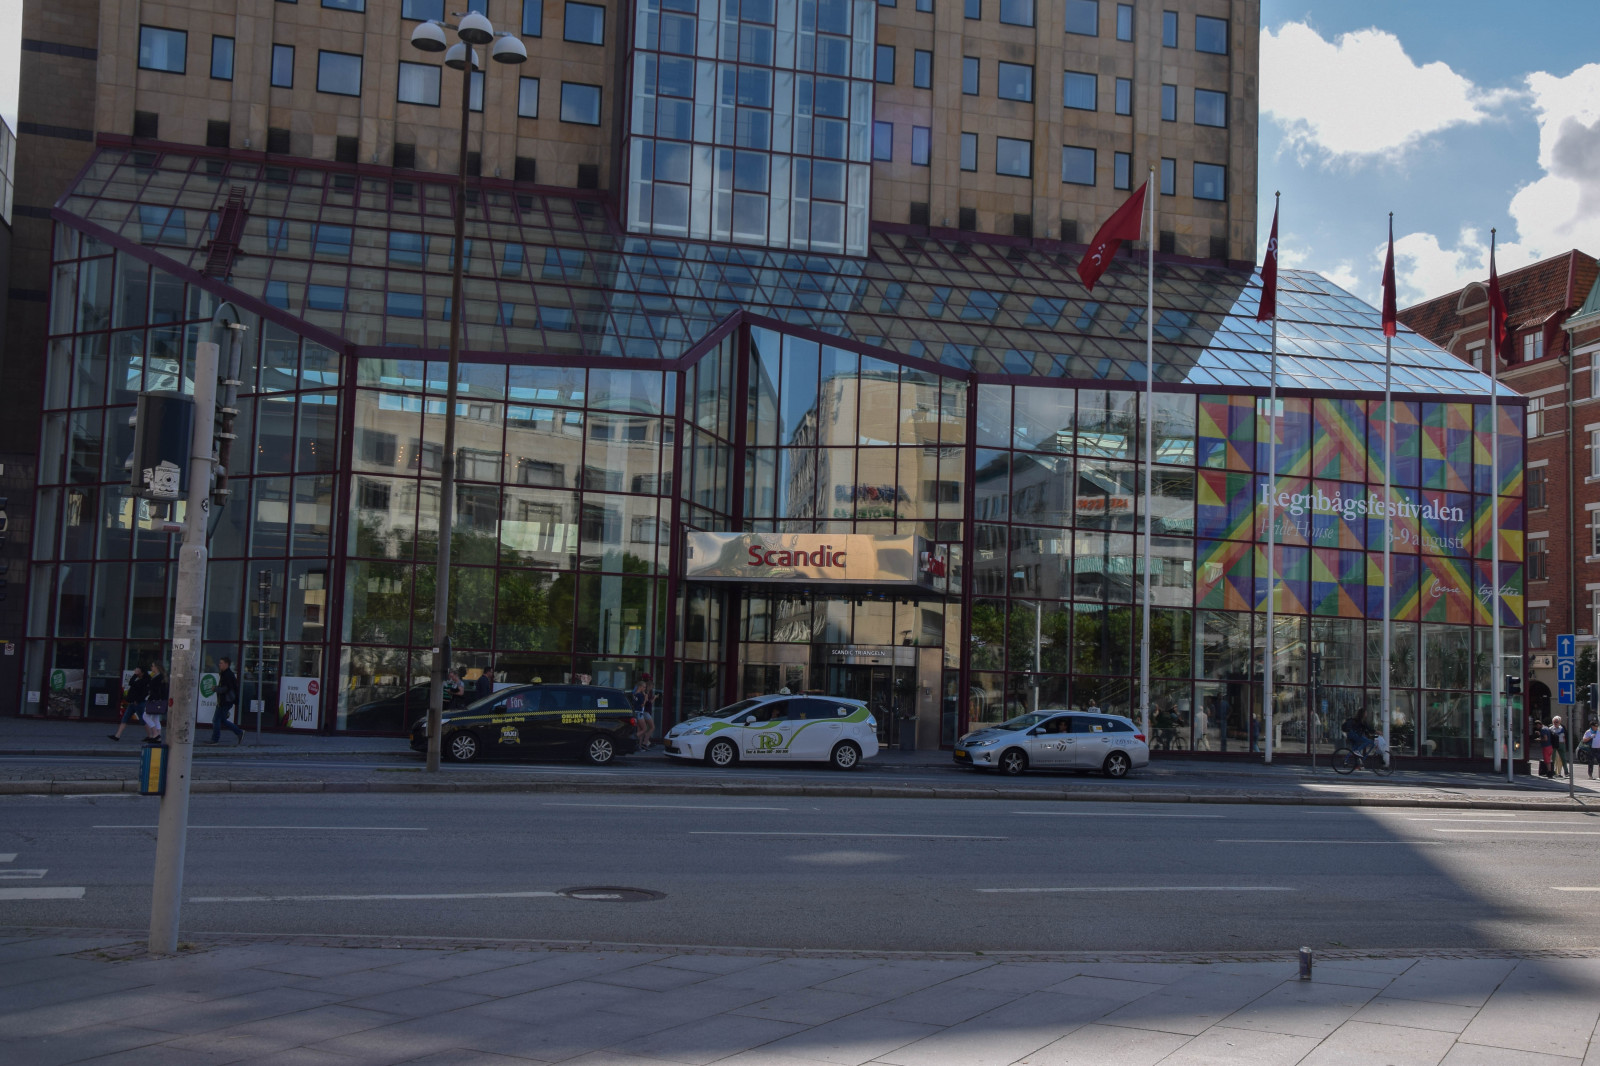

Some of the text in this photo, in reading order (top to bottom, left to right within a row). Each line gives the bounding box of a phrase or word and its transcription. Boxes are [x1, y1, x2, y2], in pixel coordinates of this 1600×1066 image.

[1260, 483, 1464, 522] Regnbågsfestivalen
[1295, 520, 1334, 539] House
[1412, 533, 1464, 552] augusti
[748, 545, 847, 568] Scandic
[1478, 584, 1520, 605] togther
[1563, 665, 1571, 679] P
[285, 703, 313, 722] BRUNCH
